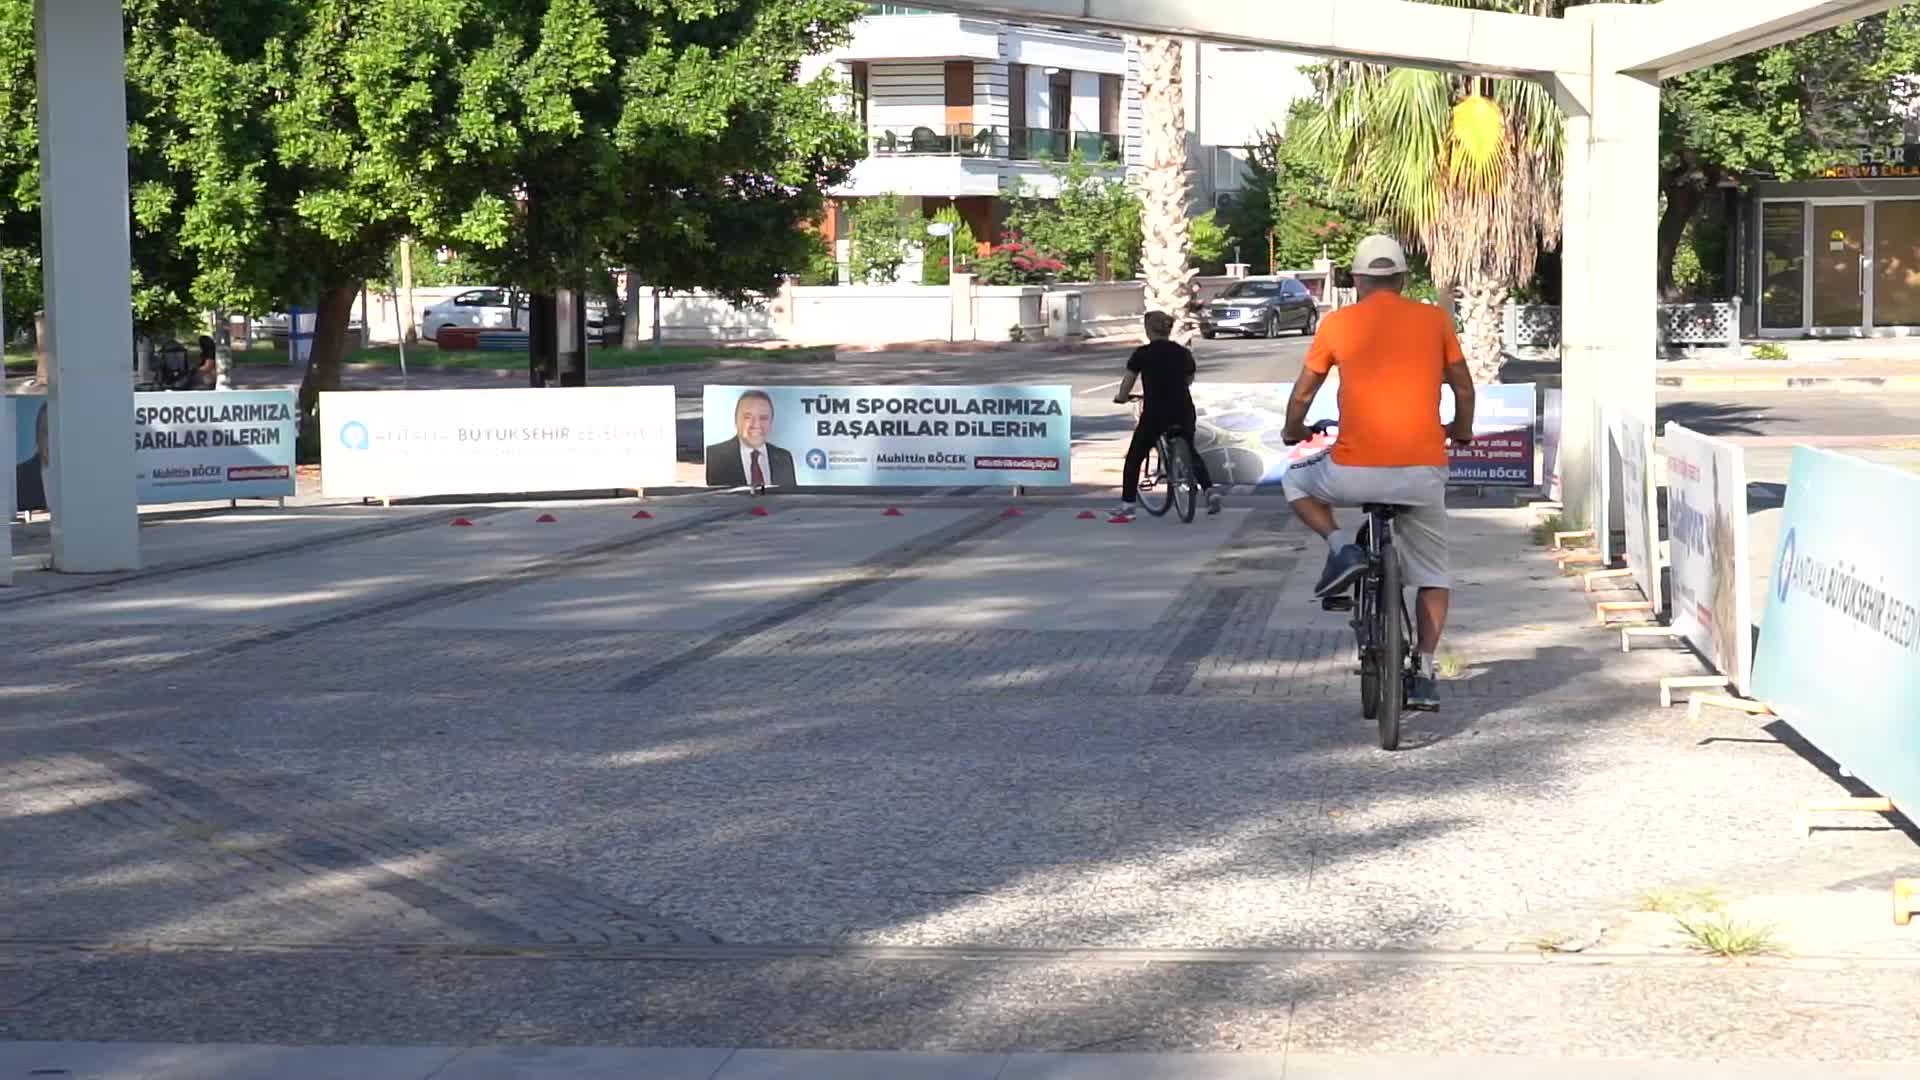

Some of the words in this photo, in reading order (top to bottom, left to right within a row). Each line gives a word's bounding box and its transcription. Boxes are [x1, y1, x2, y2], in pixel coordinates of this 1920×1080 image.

[135, 404, 290, 426] SPORCULARIMIZA
[800, 394, 850, 415] TÜM
[855, 398, 1063, 417] SPORCULARIMIZA
[816, 420, 949, 440] BAŞARILAR
[876, 452, 926, 465] Muhittin
[927, 451, 966, 465] BÖCEK
[1488, 466, 1527, 479] BÖCEK
